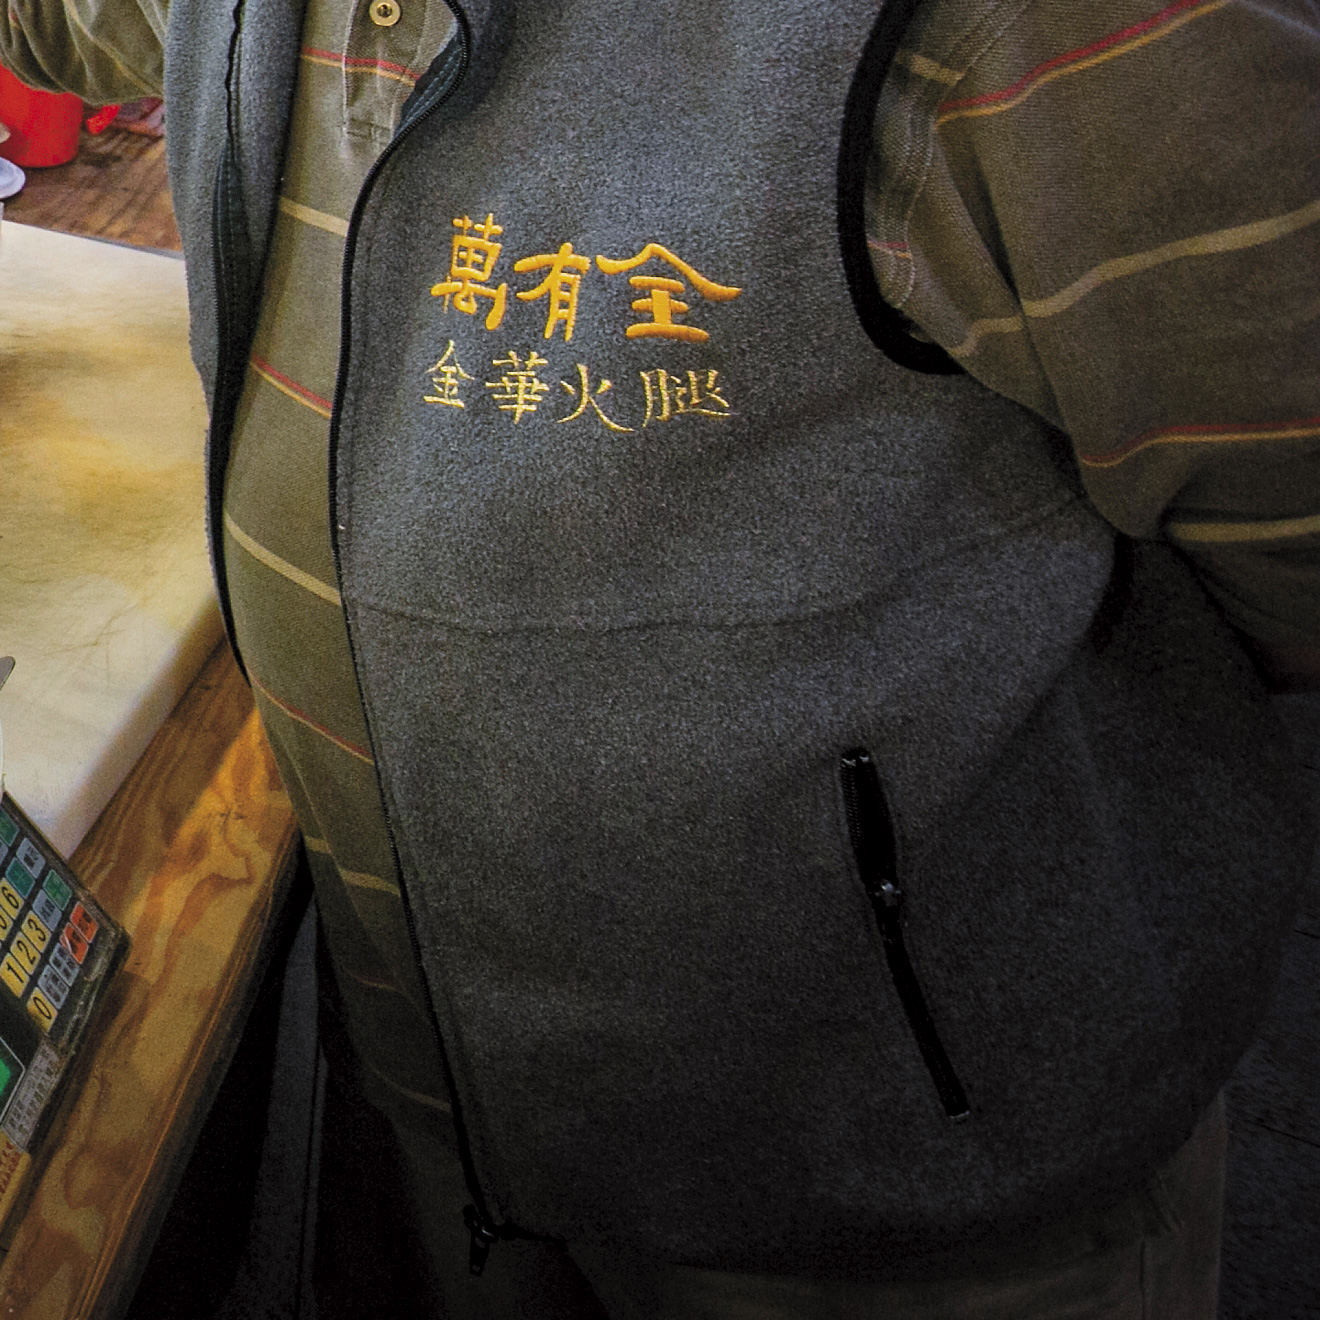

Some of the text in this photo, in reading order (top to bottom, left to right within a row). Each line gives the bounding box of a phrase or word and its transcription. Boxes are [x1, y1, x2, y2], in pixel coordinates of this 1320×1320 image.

[430, 212, 742, 342] 萬有全
[423, 340, 732, 433] 金華火腿
[1, 886, 20, 909] 6
[28, 917, 47, 940] 3
[17, 939, 37, 964] 2
[6, 962, 25, 984] 1
[33, 995, 52, 1020] 0
